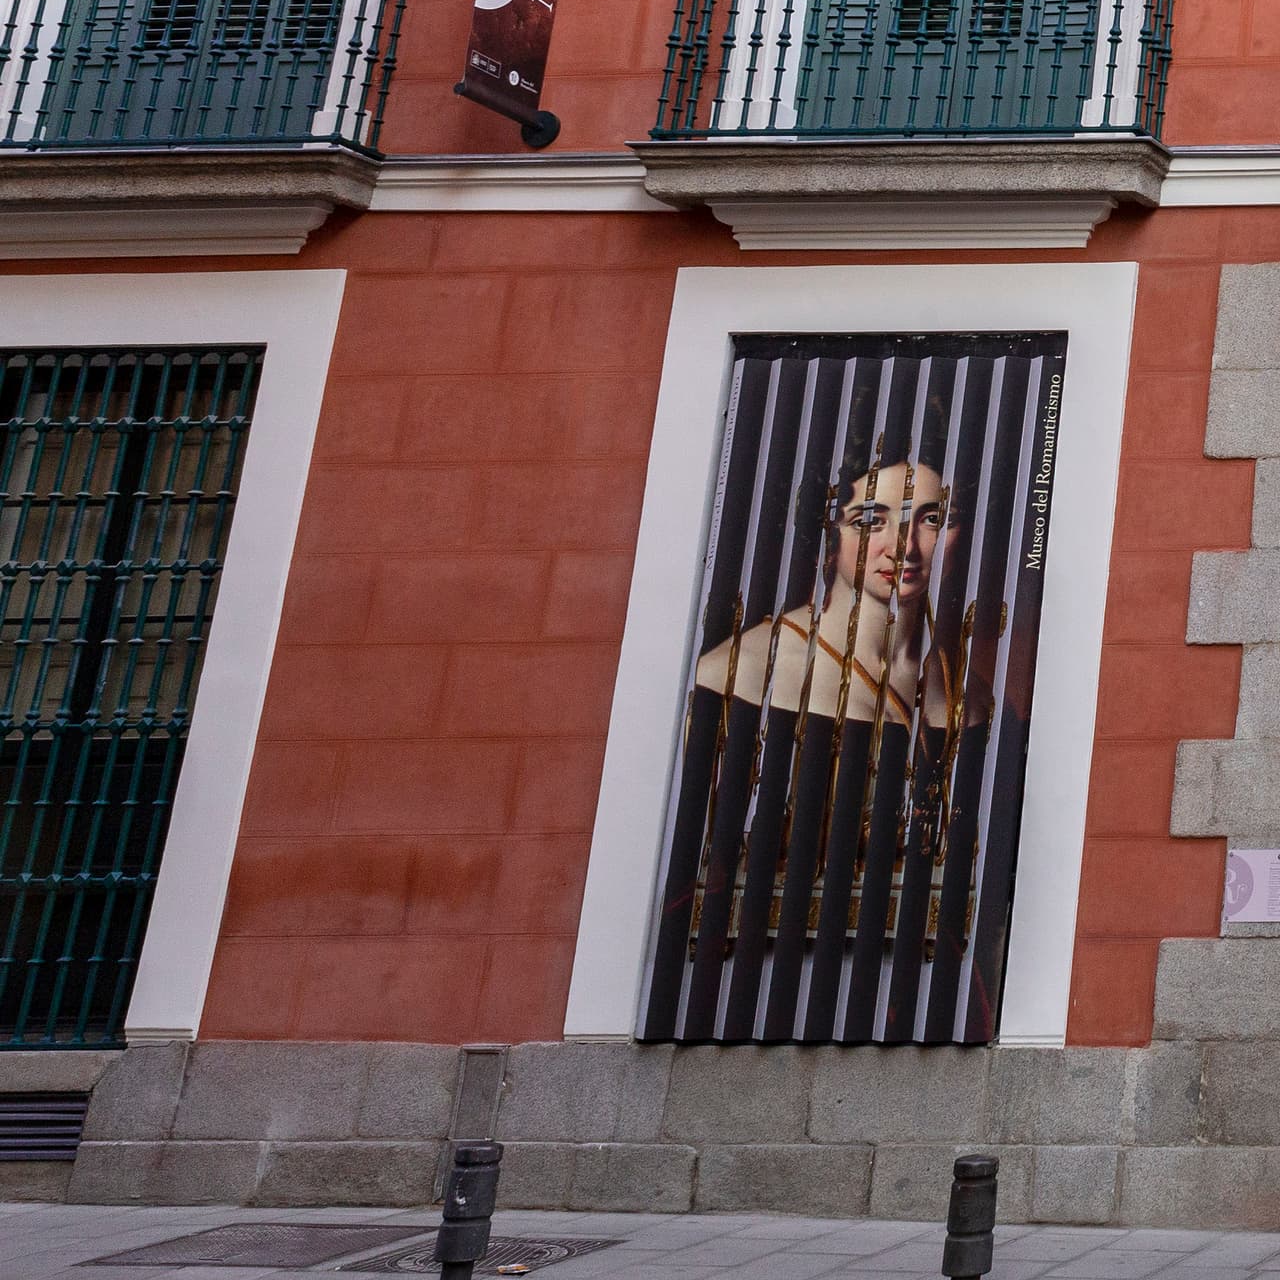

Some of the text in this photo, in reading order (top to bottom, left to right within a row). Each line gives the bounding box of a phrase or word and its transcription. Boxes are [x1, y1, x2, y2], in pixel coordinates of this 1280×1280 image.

[1026, 373, 1062, 570] Museo del Romanticismo
